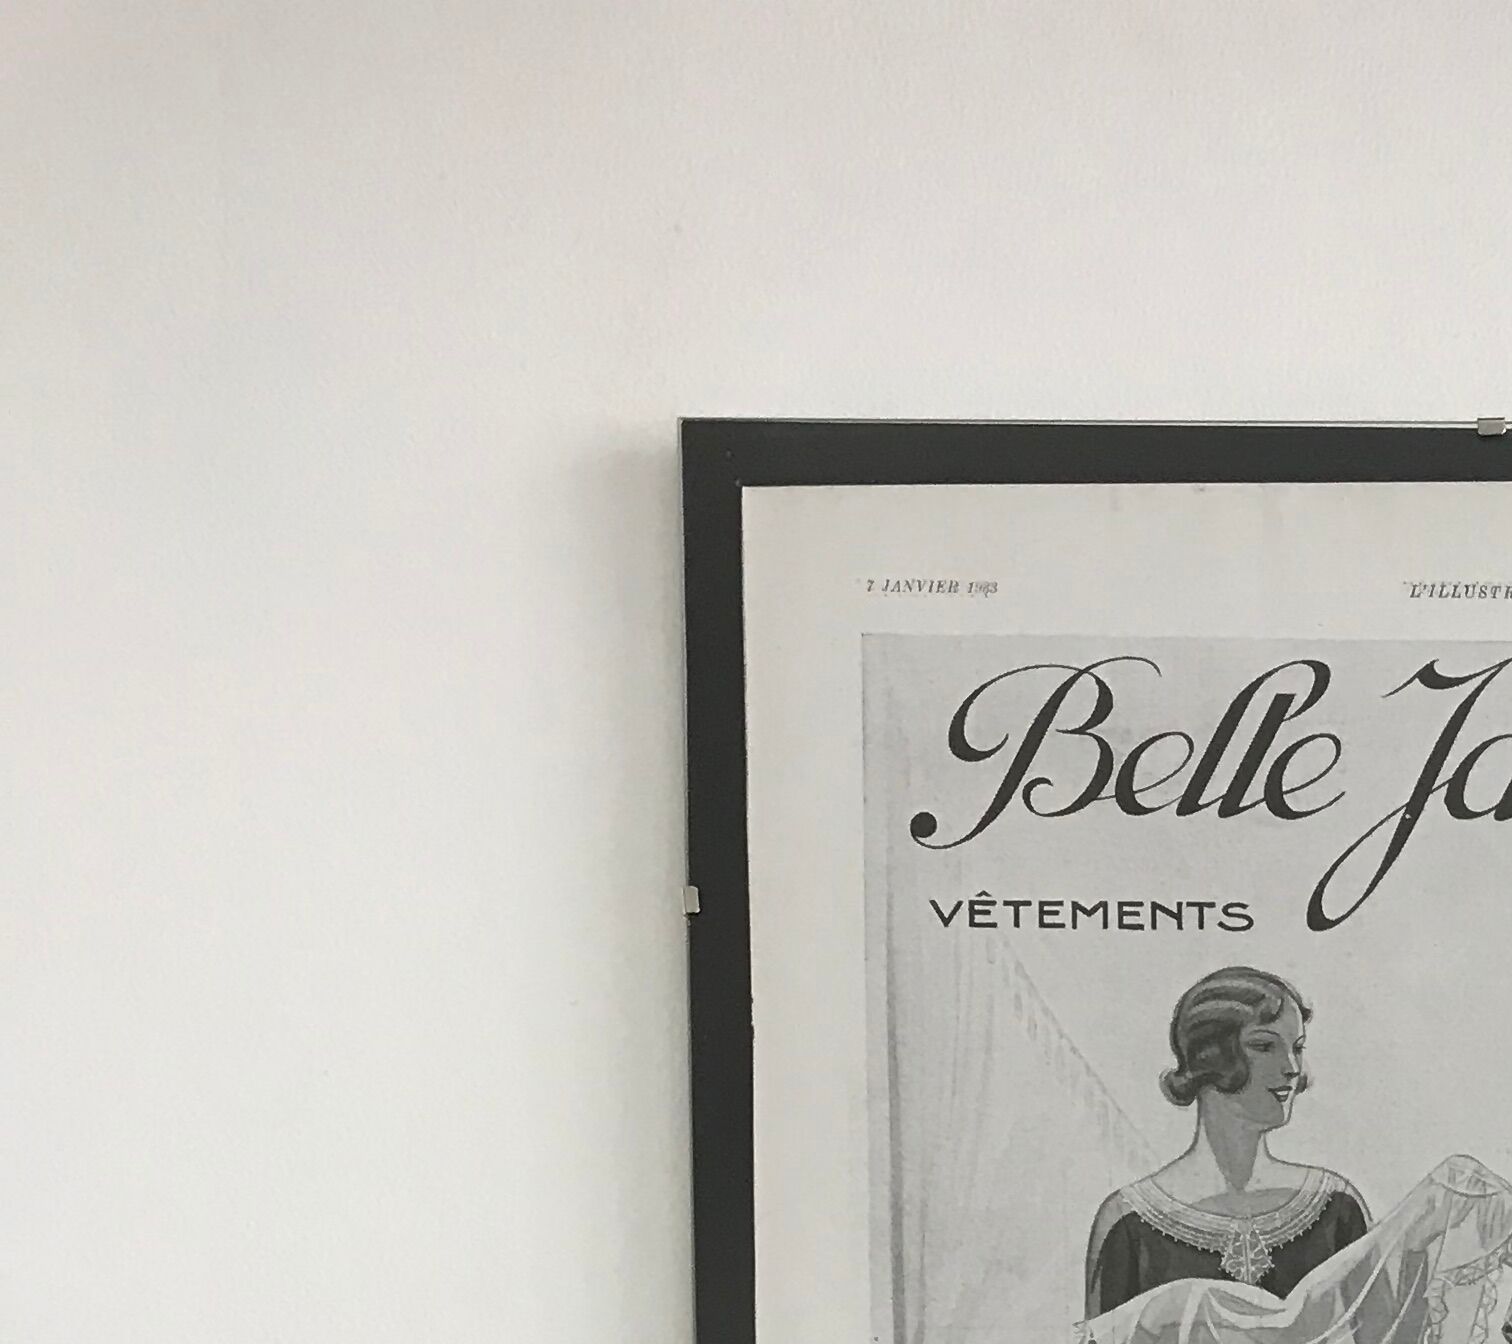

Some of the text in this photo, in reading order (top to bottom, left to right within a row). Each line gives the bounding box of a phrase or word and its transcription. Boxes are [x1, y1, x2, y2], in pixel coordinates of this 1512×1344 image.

[867, 579, 876, 592] 7
[881, 578, 960, 594] JANVIER
[909, 655, 1346, 850] Belle
[929, 890, 1254, 932] VÊTEMENTS
